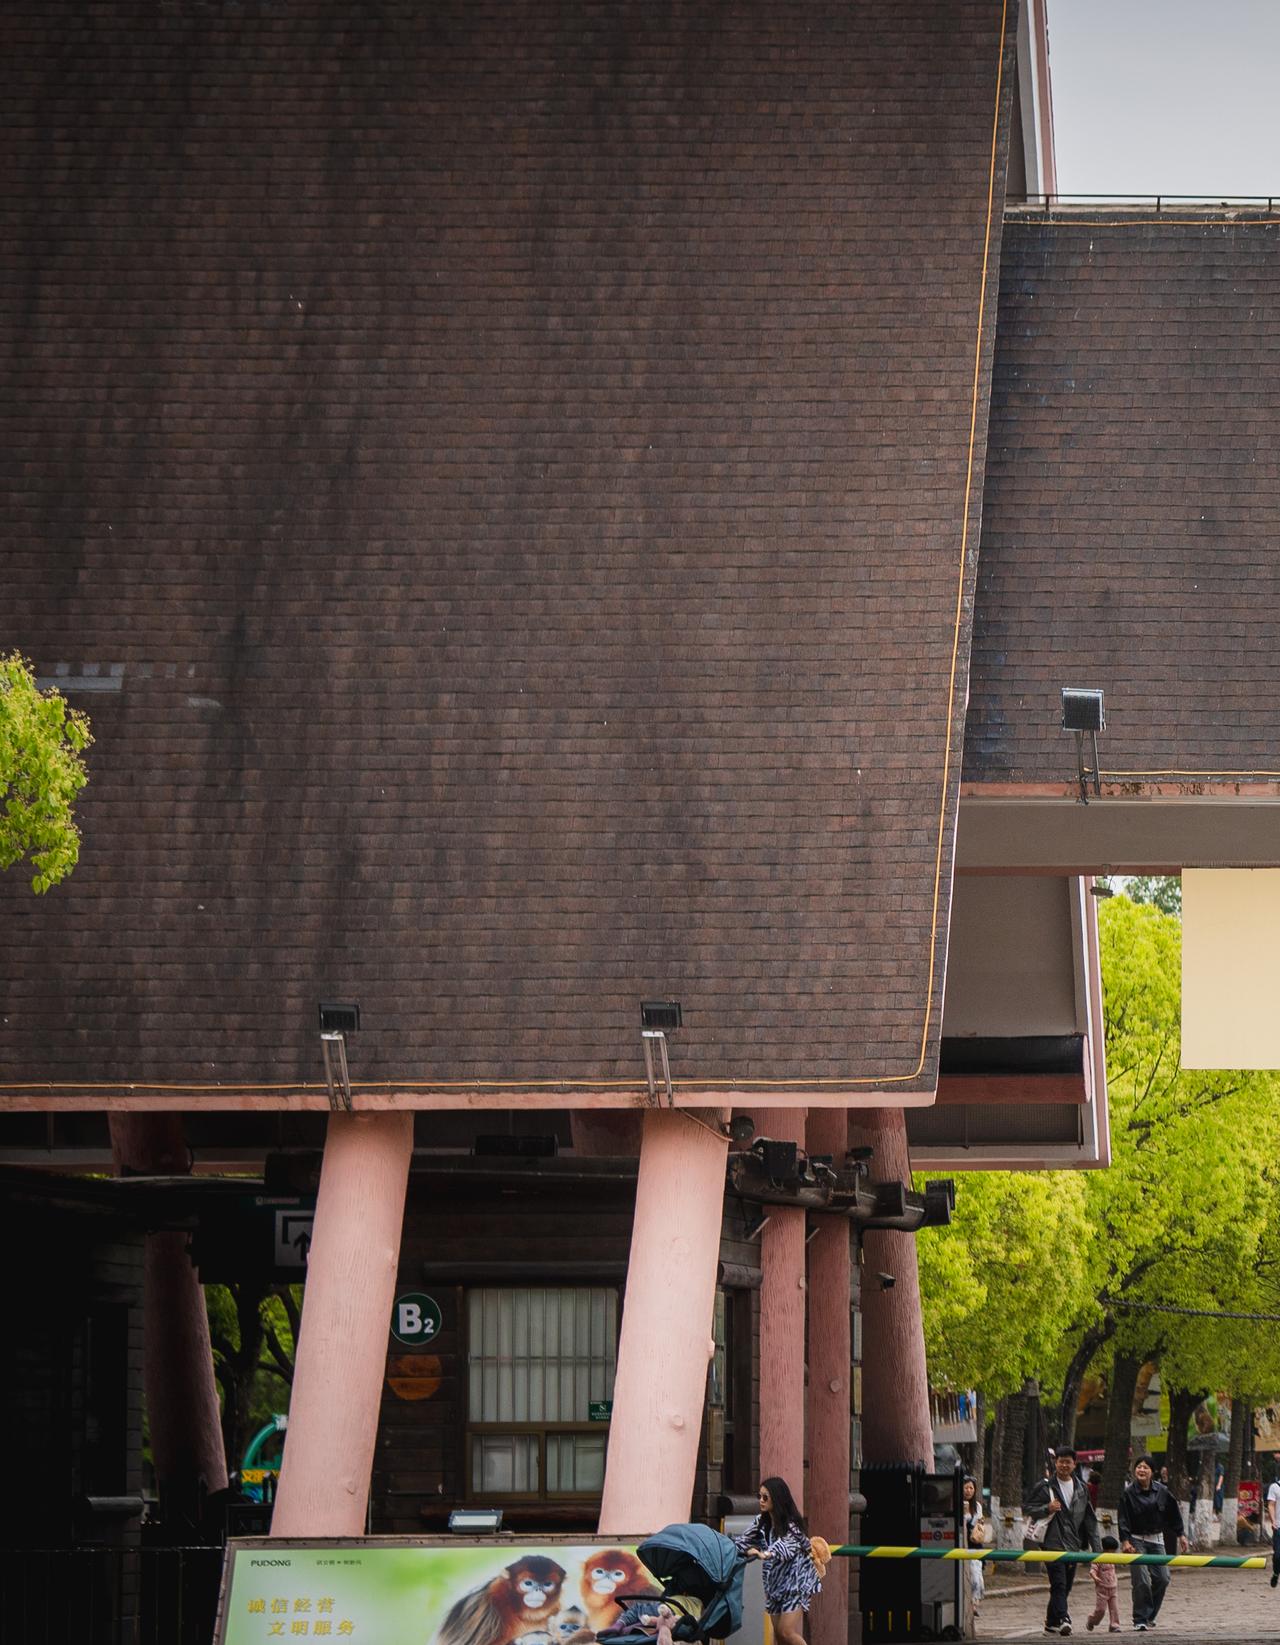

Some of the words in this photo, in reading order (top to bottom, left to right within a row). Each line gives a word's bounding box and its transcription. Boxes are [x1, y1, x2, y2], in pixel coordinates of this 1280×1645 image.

[398, 1303, 435, 1334] B2
[250, 1559, 292, 1567] PUDONG
[248, 1597, 335, 1613] 诚信经营
[268, 1620, 355, 1635] 文明服务
